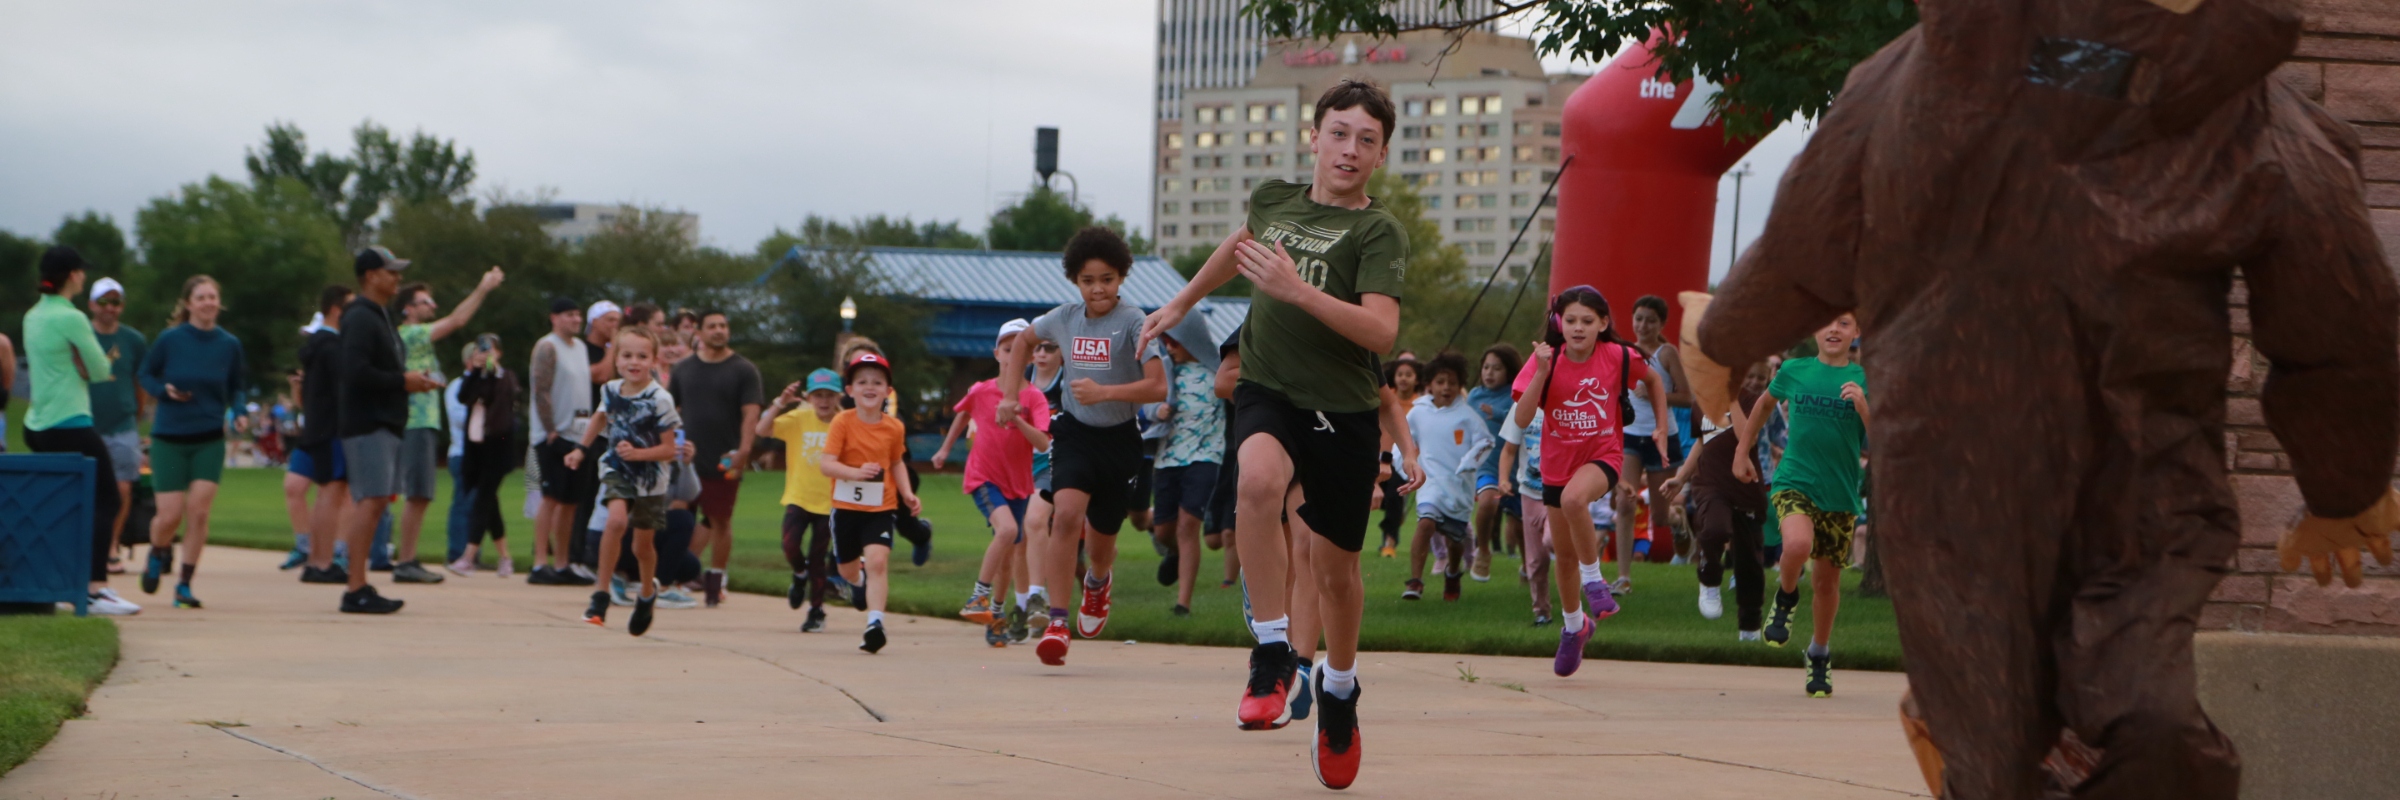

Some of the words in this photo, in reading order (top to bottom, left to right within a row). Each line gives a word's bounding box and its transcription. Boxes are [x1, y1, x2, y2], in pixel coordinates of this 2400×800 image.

[1640, 77, 1676, 99] the
[1261, 226, 1303, 247] PAT'S
[1296, 237, 1334, 254] RUN
[1074, 340, 1107, 356] USA
[1795, 393, 1856, 412] UNDER
[1552, 409, 1587, 420] Girls
[1795, 406, 1855, 420] ARMOUR
[1570, 420, 1597, 429] run
[853, 487, 862, 501] 5
